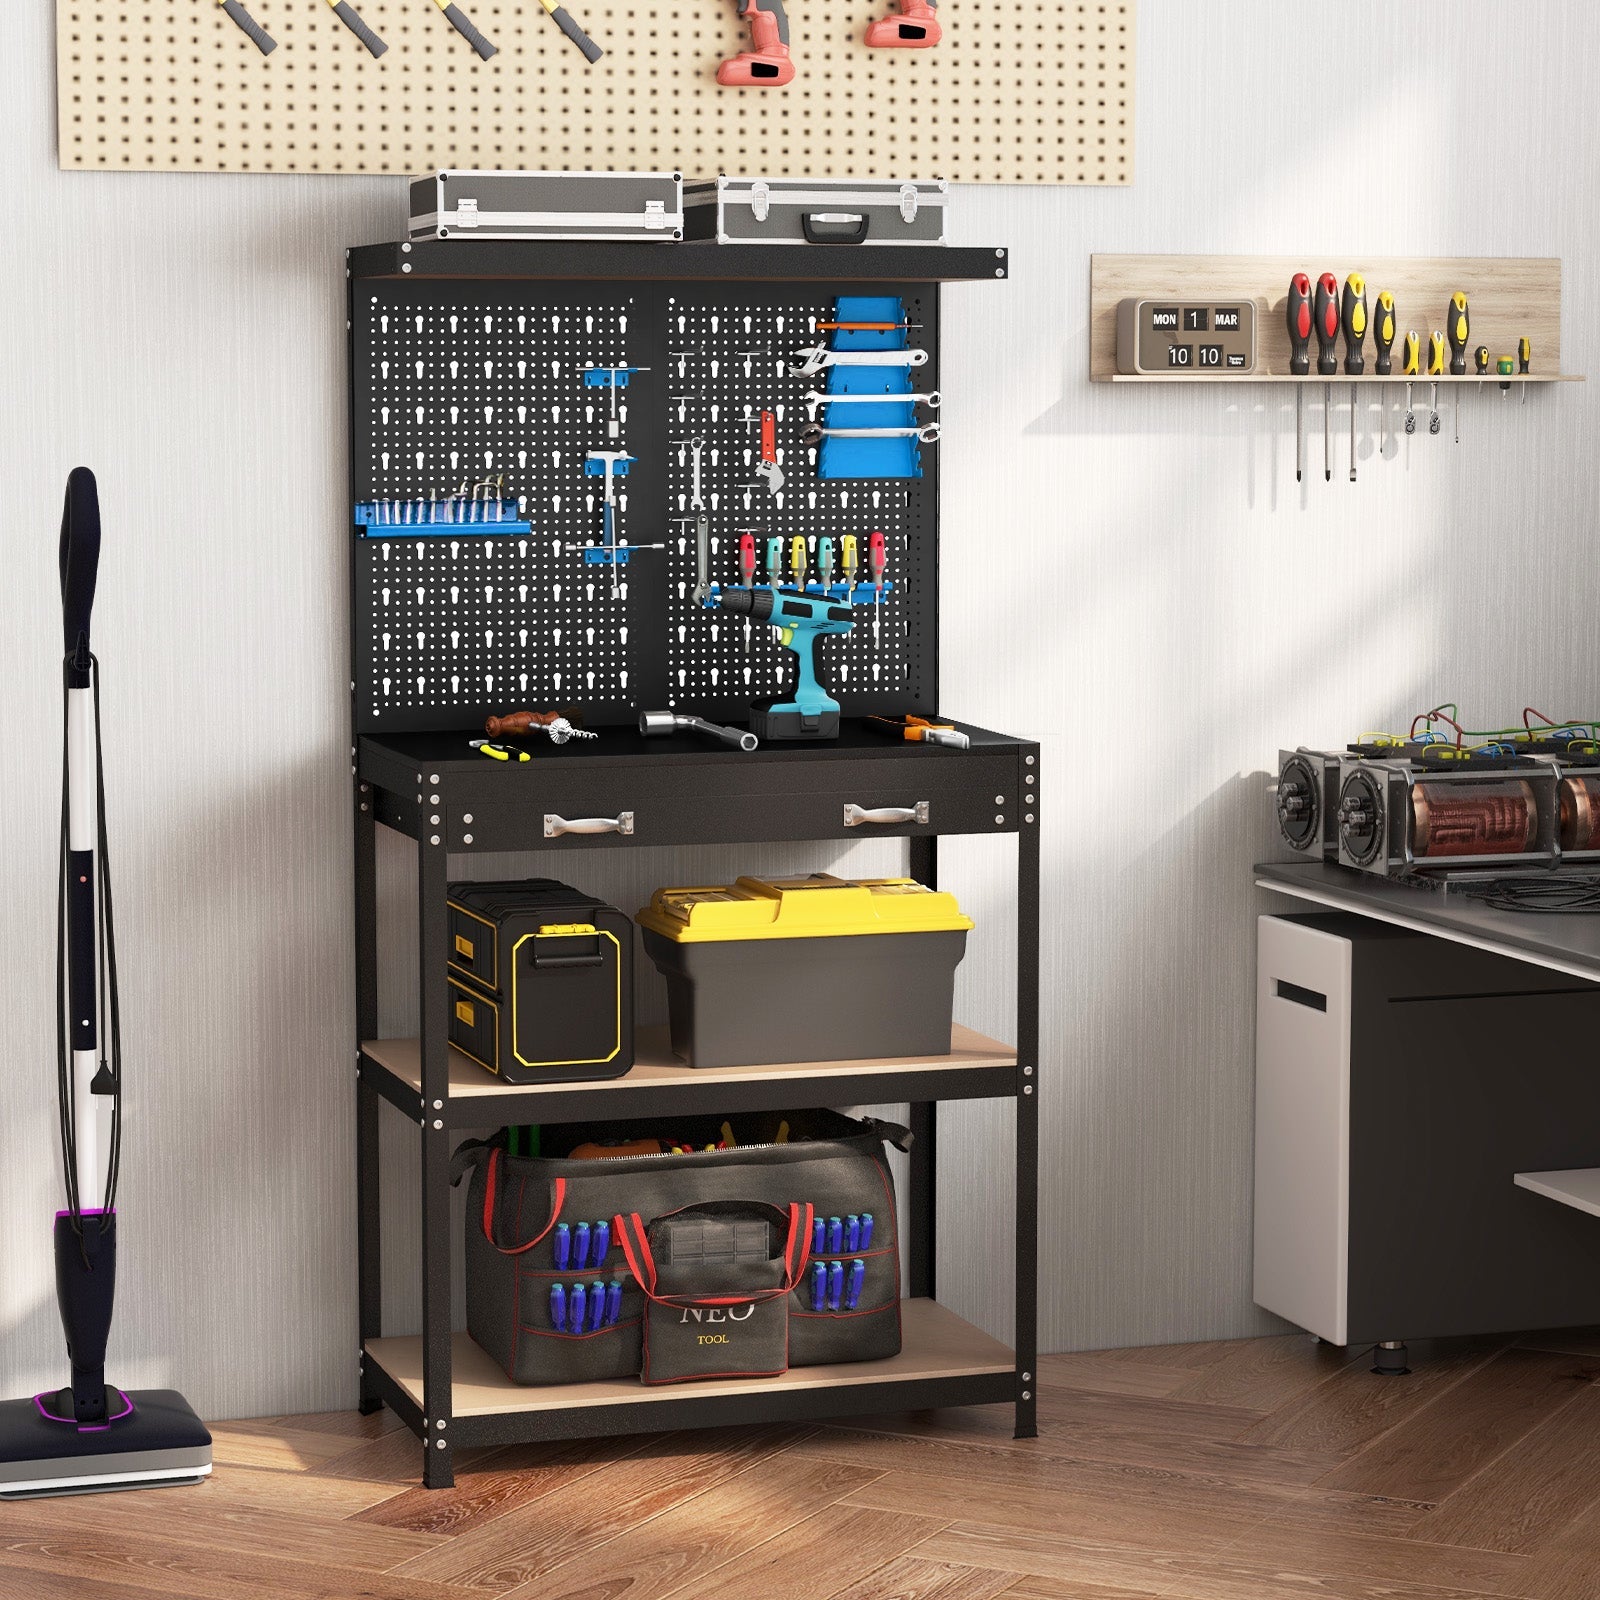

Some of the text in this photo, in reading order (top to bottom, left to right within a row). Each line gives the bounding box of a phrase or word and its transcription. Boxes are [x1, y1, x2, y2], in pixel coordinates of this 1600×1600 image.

[1153, 311, 1238, 328] MON 1 MAR
[1169, 348, 1188, 364] 10
[1200, 348, 1219, 364] 10
[680, 1304, 755, 1323] NEO
[697, 1334, 730, 1345] TOOL
